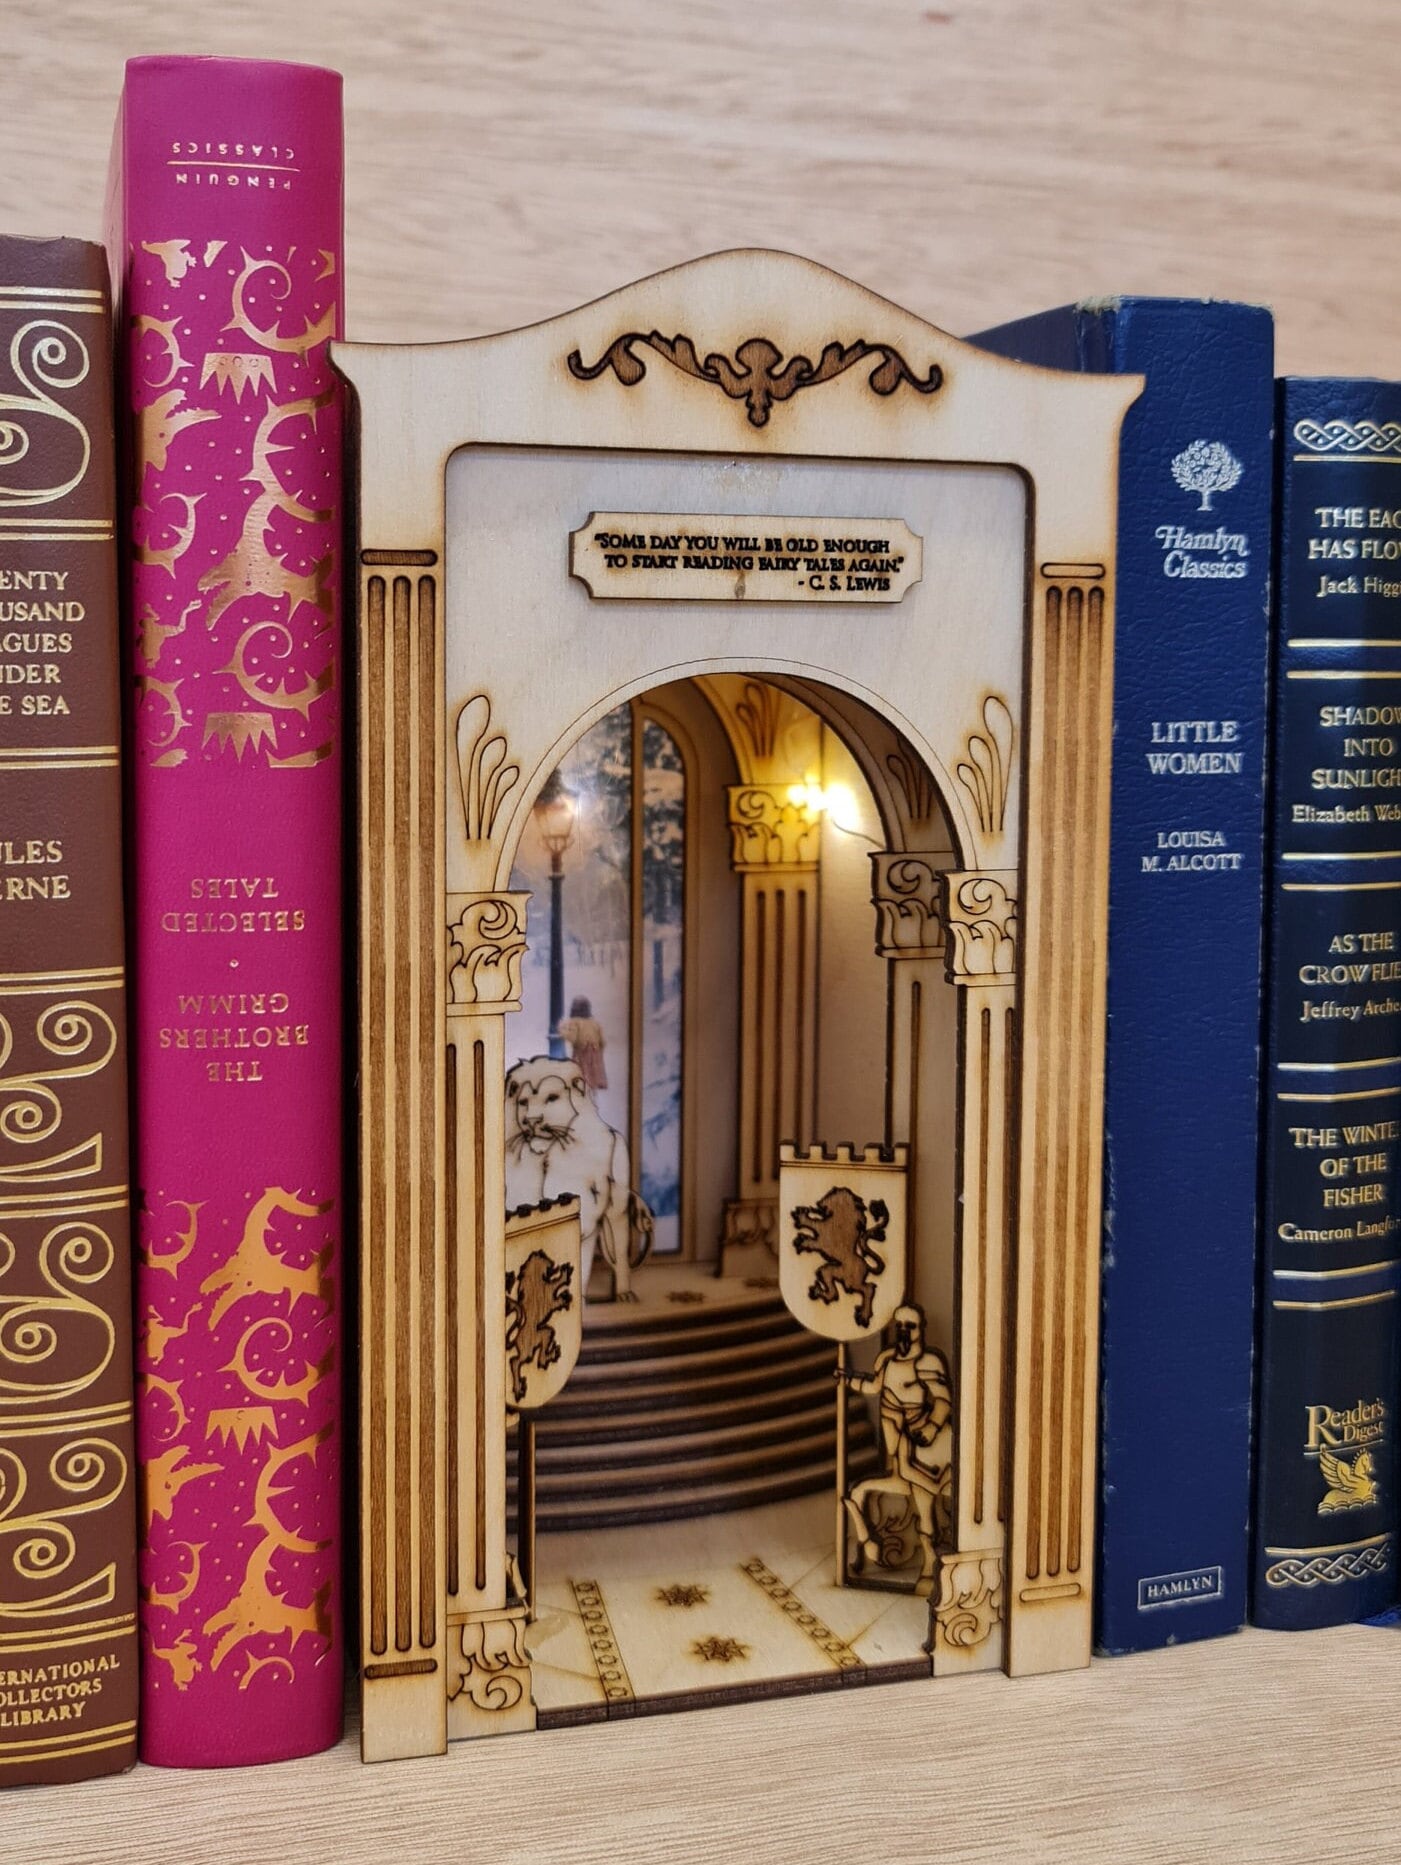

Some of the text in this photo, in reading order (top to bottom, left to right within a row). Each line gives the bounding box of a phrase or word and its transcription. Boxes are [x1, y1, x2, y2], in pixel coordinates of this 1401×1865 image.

[172, 142, 295, 159] CLASSICS
[176, 173, 291, 190] PENGUIN
[1315, 507, 1364, 528] THE
[650, 536, 682, 550] DAY
[684, 536, 719, 550] YOU
[721, 537, 760, 551] WILL
[765, 538, 782, 551] BE
[786, 539, 818, 552] OLD
[823, 540, 889, 553] ENOUGH
[1155, 525, 1249, 557] Hamlyn
[1308, 538, 1401, 559] HAS FLO
[605, 555, 627, 568] TO
[632, 555, 678, 568] START
[683, 556, 753, 570] READING
[759, 557, 800, 571] FAIRY
[804, 558, 844, 571] TALES
[1163, 550, 1248, 578] Classics
[809, 575, 825, 591] C.
[830, 576, 841, 591] S.
[847, 576, 890, 591] LEWIS
[1316, 575, 1401, 598] Jack Higg
[0, 632, 73, 653] GUES
[0, 663, 61, 684] DER
[21, 694, 71, 716] SEA
[1151, 721, 1239, 743] LITTLE
[1344, 738, 1394, 757] INTO
[1145, 752, 1243, 775] WOMEN
[1292, 804, 1370, 823] Elizabeth
[1157, 831, 1225, 848] LOUISA
[0, 840, 63, 865] LES
[1141, 853, 1241, 872] M. ALCOTT
[0, 874, 71, 900] RNE
[191, 877, 279, 898] TALES
[161, 910, 305, 932] SELECTED
[1328, 931, 1394, 953] AS THE
[1299, 964, 1369, 984] CROW
[178, 993, 289, 1014] GRIMM
[1300, 997, 1401, 1022] Jeffrey Arche
[159, 1024, 309, 1048] BROTHERS
[206, 1061, 263, 1081] THE
[1288, 1121, 1401, 1146] THE WINTE
[1319, 1152, 1388, 1178] OF THE
[1322, 1183, 1384, 1207] FISHER
[1278, 1222, 1352, 1241] Cameron
[1343, 1420, 1384, 1443] Digest
[1147, 1575, 1213, 1598] HAMLYN
[0, 1701, 86, 1727] LIBRARY
